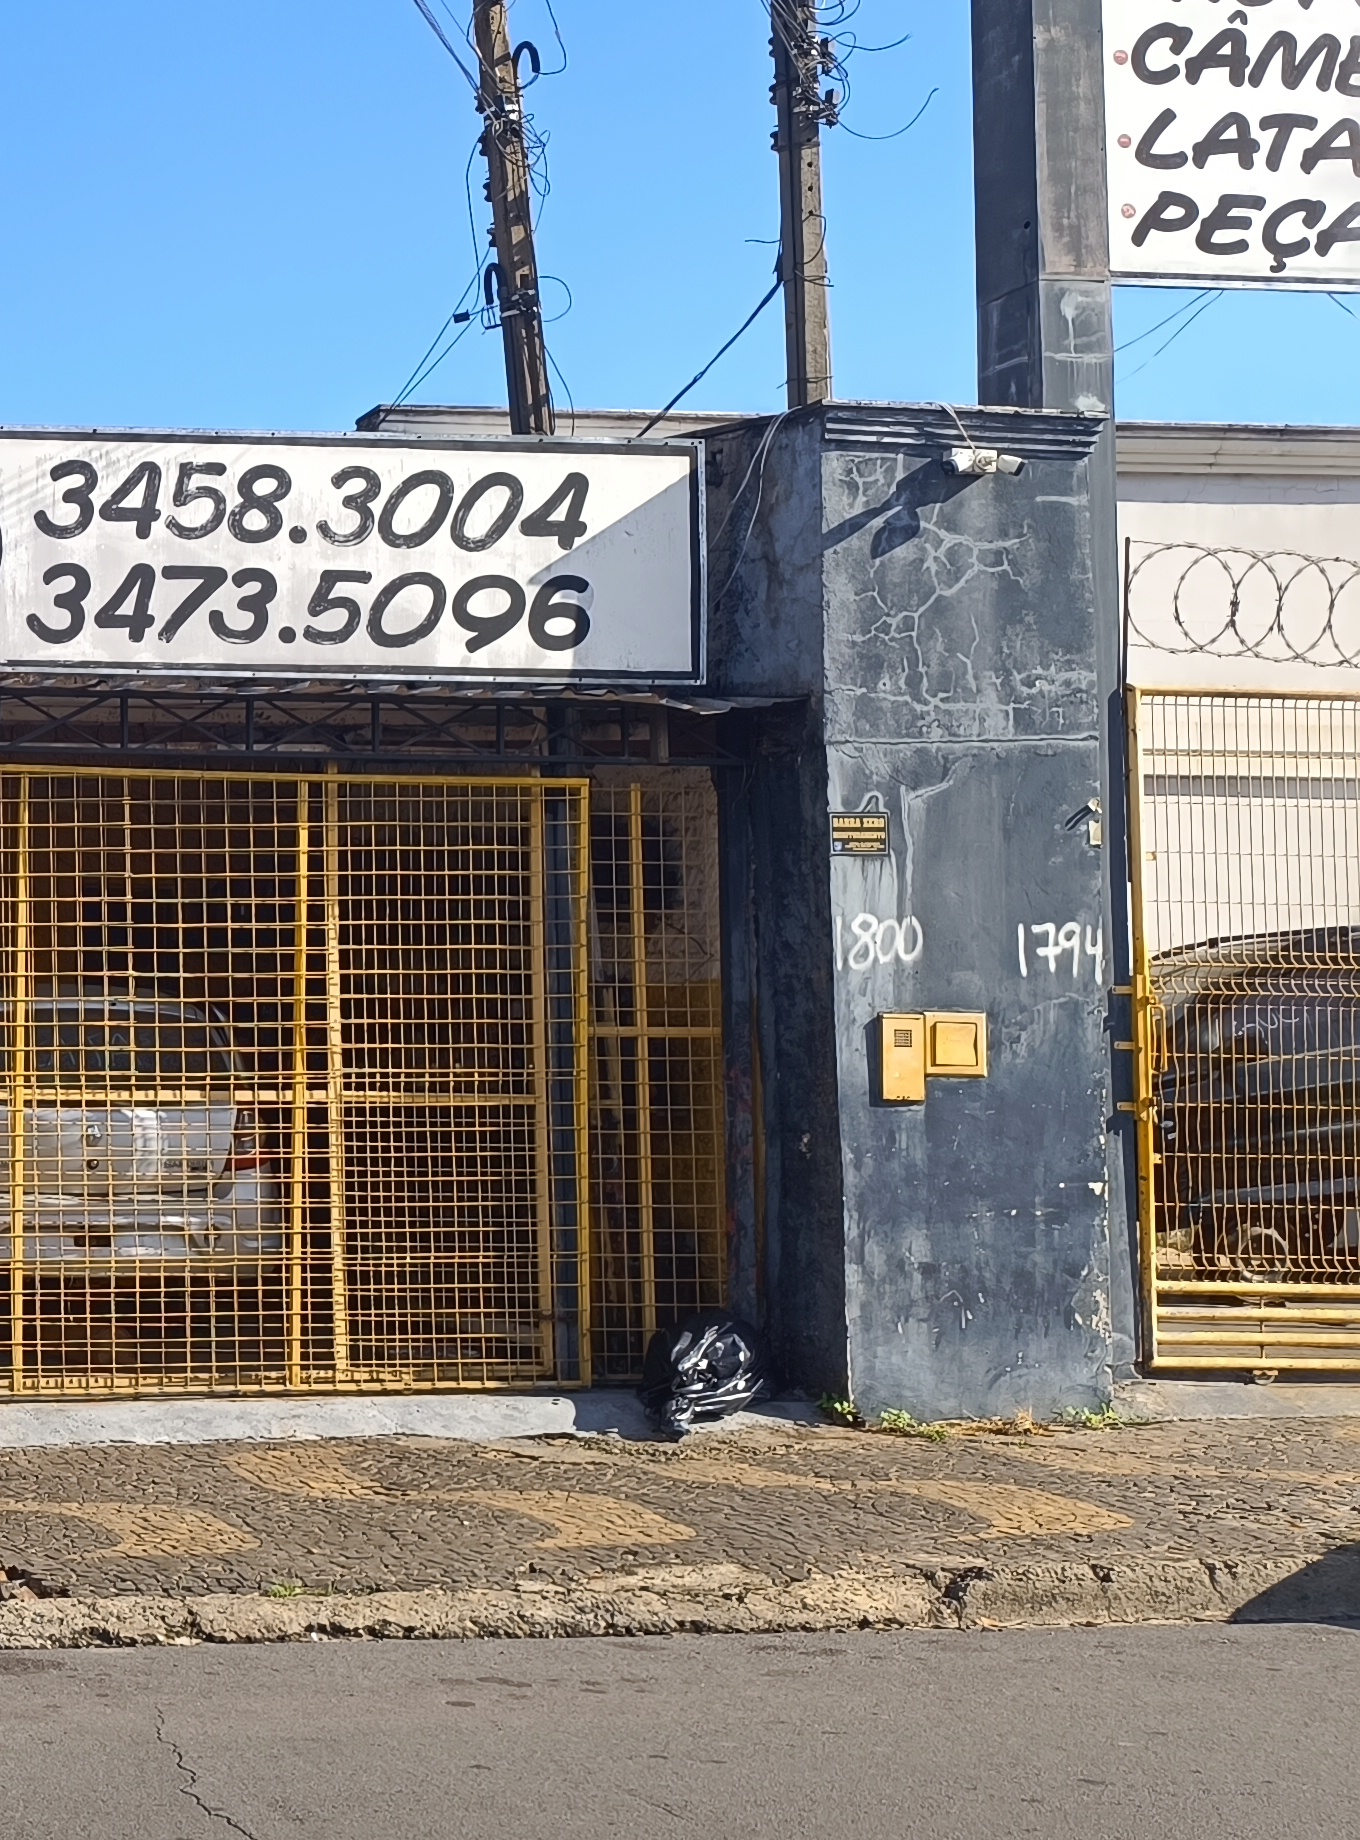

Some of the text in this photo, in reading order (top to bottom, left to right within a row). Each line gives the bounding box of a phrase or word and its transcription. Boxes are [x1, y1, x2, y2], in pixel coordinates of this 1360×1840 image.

[1135, 108, 1360, 178] LATA
[33, 460, 589, 551] 3458.3004
[26, 562, 592, 654] 3473.5096
[836, 912, 923, 971] 1800
[1018, 921, 1103, 985] 1794
